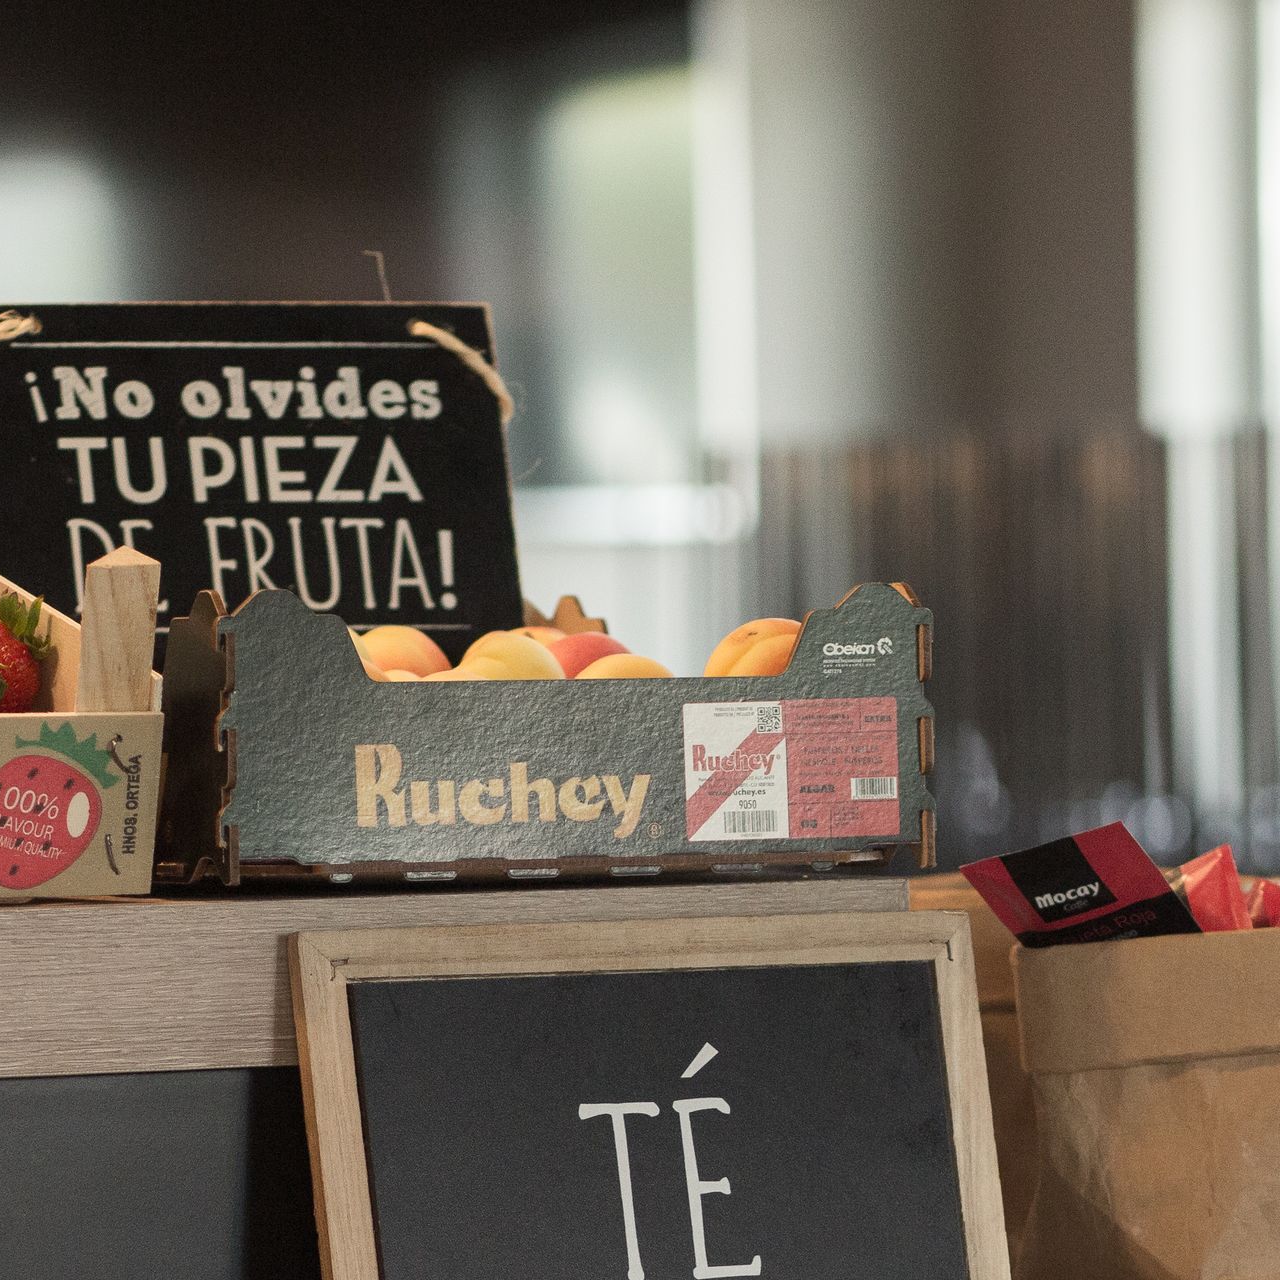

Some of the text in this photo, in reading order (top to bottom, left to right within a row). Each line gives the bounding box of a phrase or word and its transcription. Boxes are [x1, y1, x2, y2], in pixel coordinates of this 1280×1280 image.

[24, 365, 444, 424] ¡No olvides
[56, 434, 424, 504] TU PIEZA
[203, 514, 459, 613] FRUTA!
[125, 754, 143, 811] ORTEGA
[692, 744, 775, 776] Ruchey
[354, 742, 652, 840] Ruchey
[24, 840, 64, 860] QUALITY
[1034, 881, 1100, 909] Mocay
